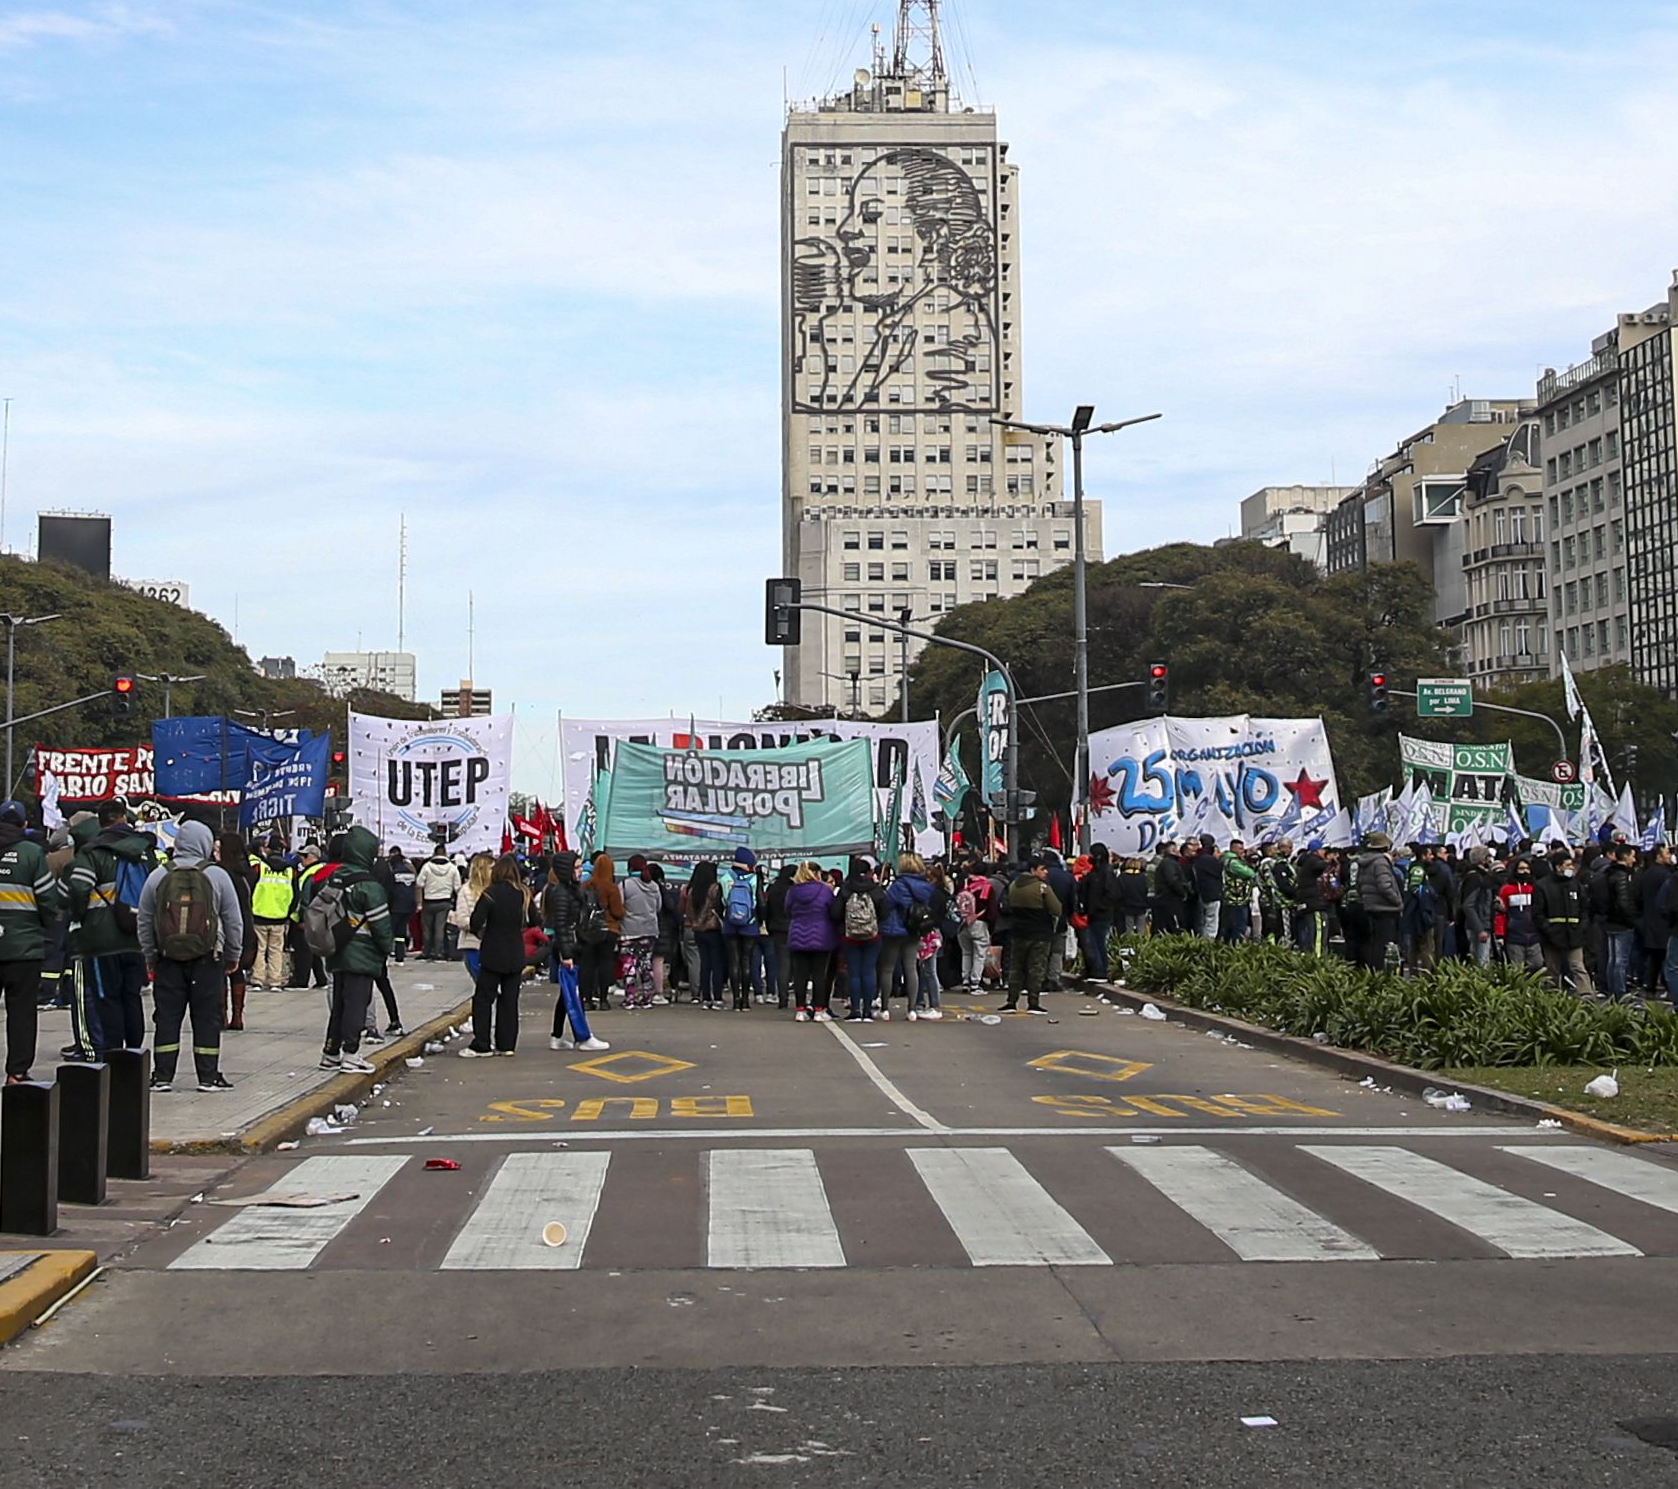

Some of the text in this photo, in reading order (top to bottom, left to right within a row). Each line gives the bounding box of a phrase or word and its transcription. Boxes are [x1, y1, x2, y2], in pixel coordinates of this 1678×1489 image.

[1444, 697, 1461, 705] LIMA
[38, 750, 130, 774] FRENTE
[1170, 732, 1276, 762] ORGANIZACIÓN
[387, 756, 489, 807] UTEP
[1108, 749, 1174, 818] 25
